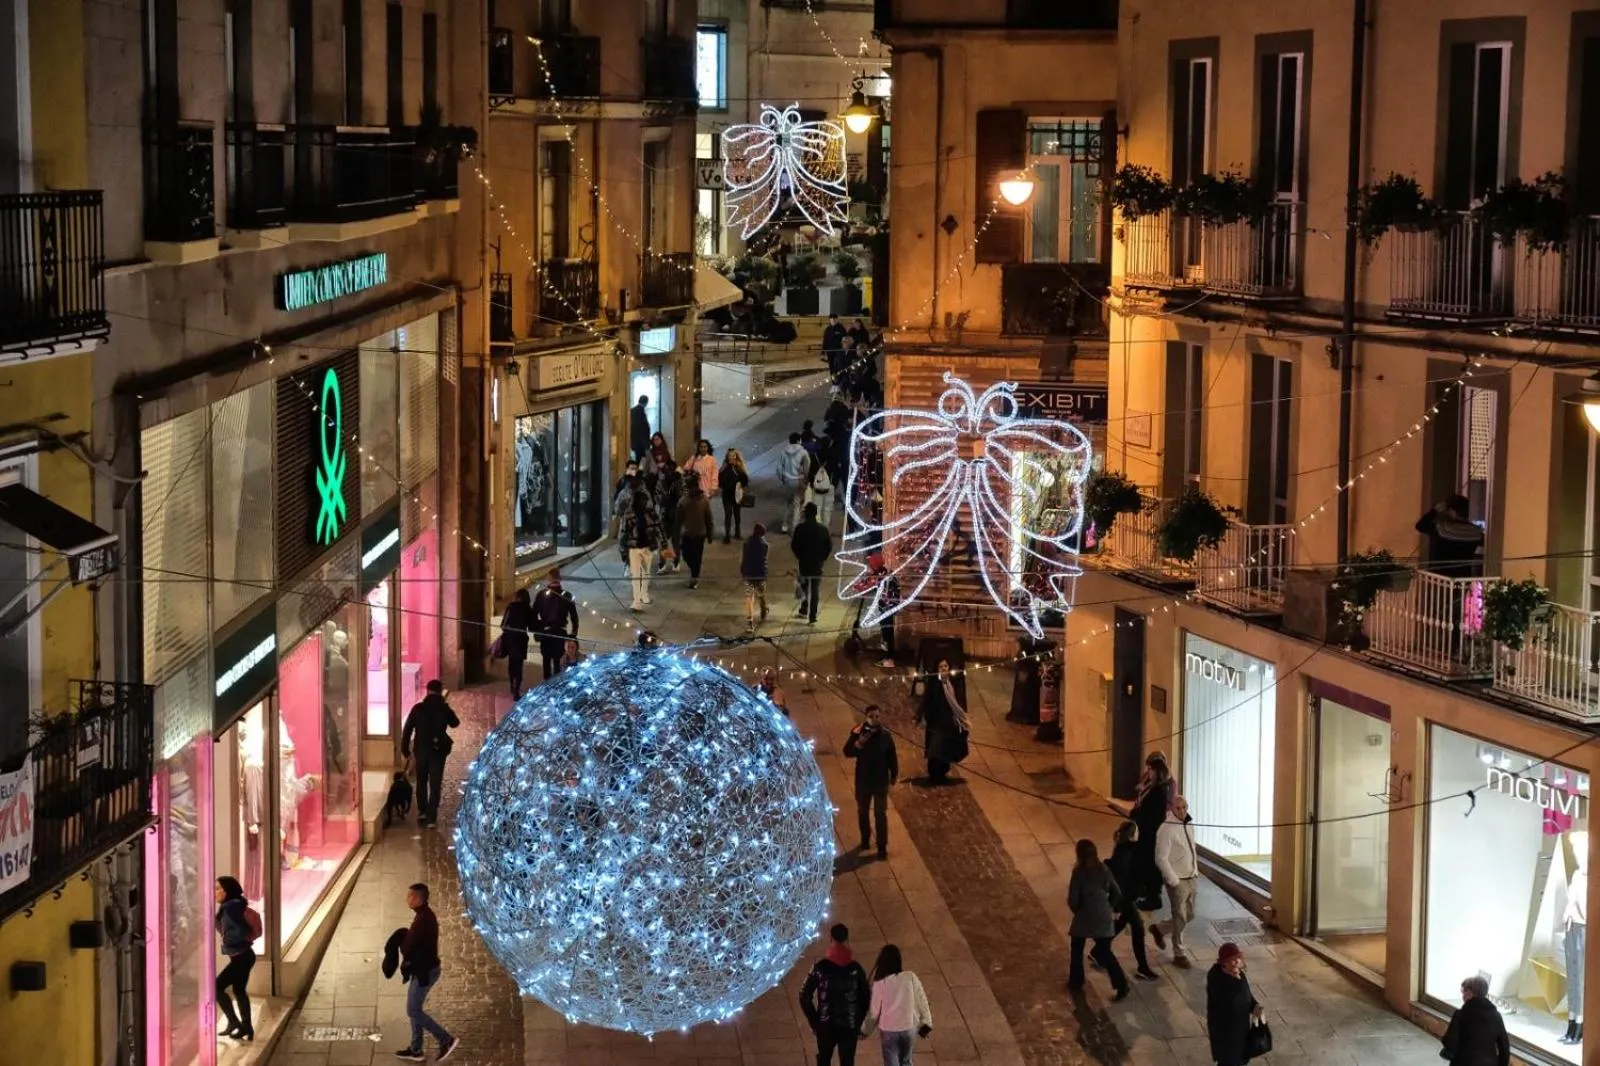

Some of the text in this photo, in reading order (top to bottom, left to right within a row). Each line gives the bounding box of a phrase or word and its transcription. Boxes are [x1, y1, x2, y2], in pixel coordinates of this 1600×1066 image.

[284, 271, 315, 312] UNITED
[1012, 392, 1101, 409] EXIBIT
[1185, 653, 1240, 691] motivi
[1487, 767, 1580, 819] motivi
